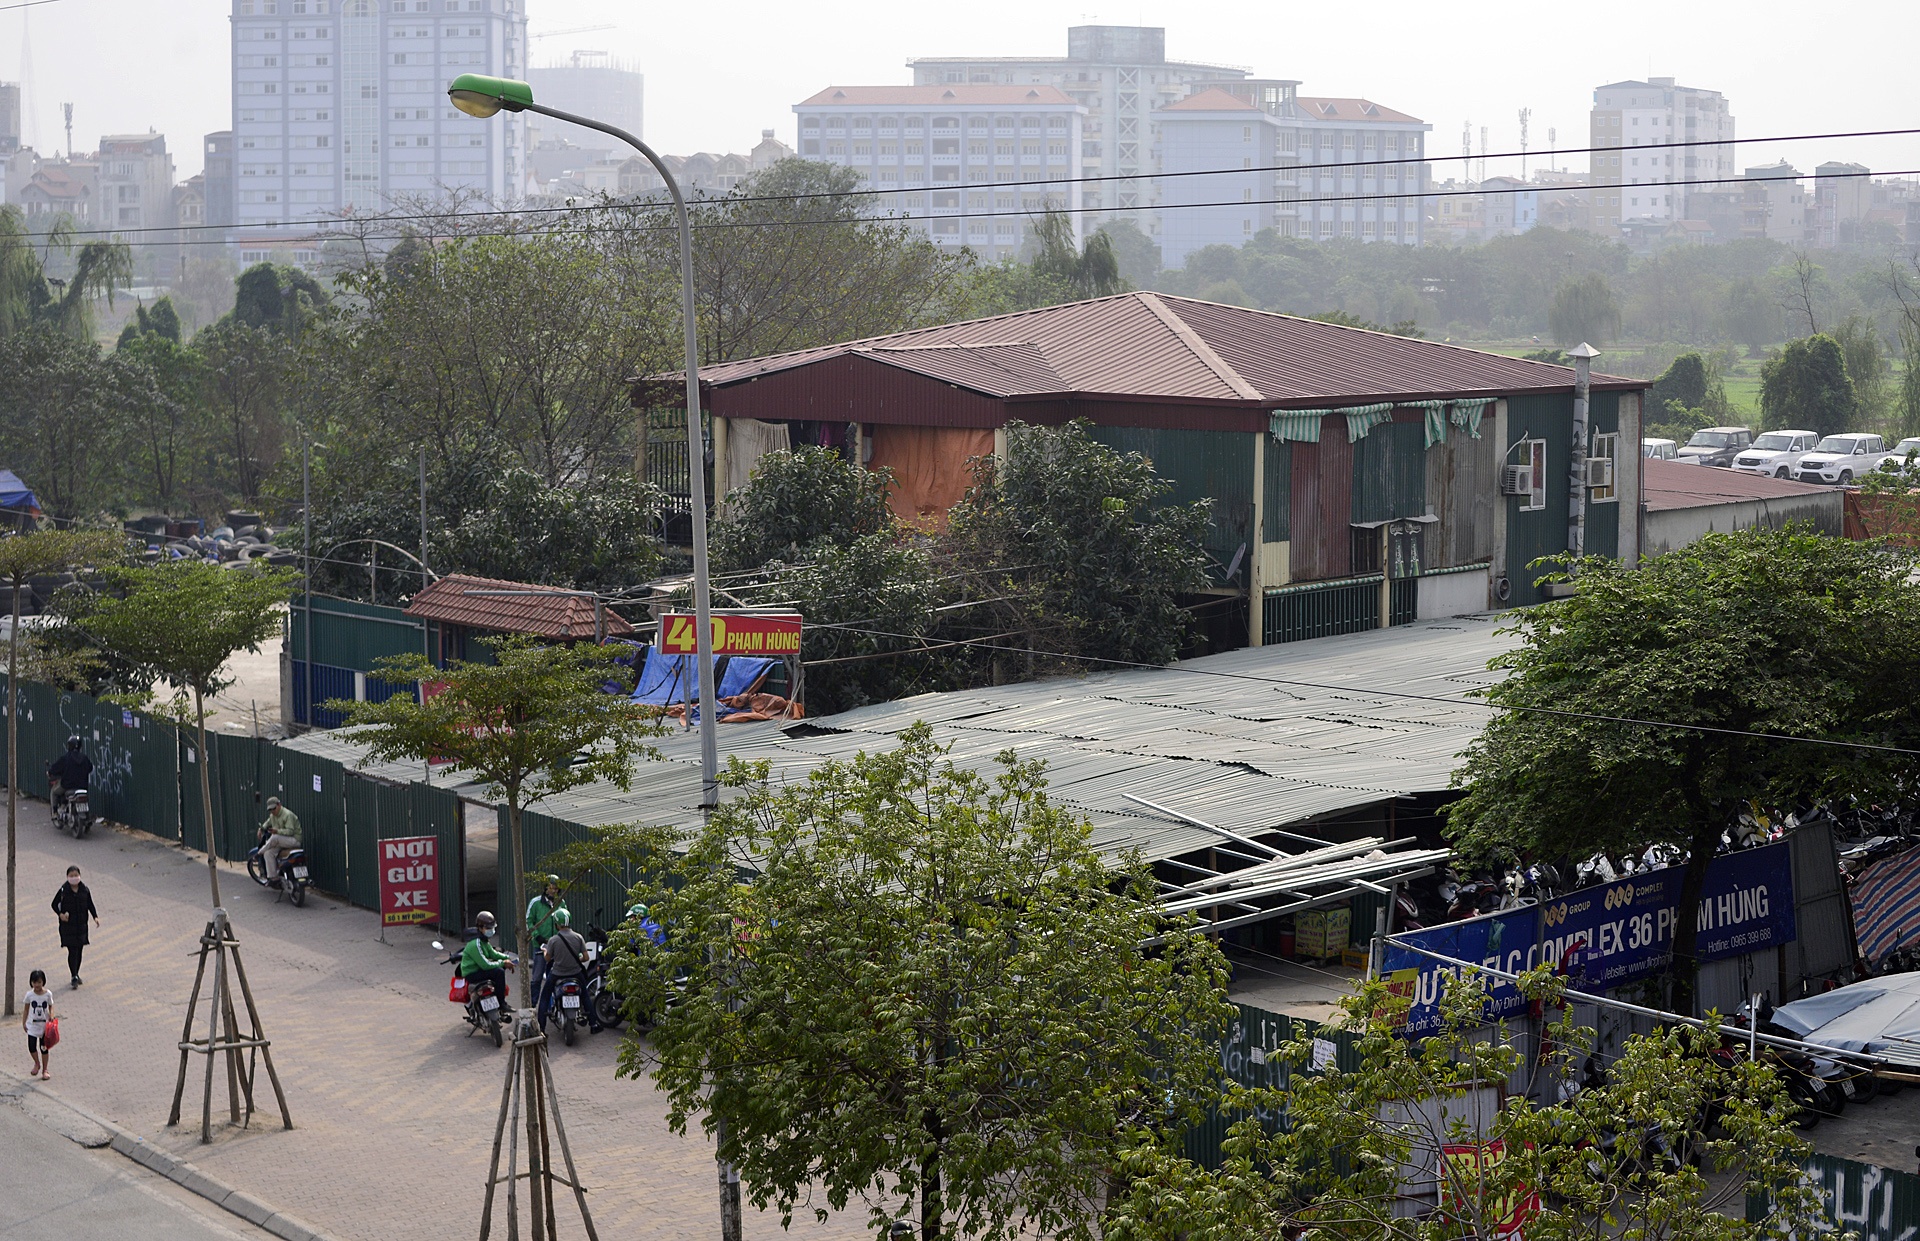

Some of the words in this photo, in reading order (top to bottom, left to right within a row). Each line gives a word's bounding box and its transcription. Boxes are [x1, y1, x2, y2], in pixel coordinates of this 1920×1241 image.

[727, 632, 763, 654] PHẠM
[766, 629, 800, 650] HÙNG
[385, 840, 433, 859] NƠI
[387, 860, 433, 883] GỬI
[393, 890, 428, 907] XE
[1606, 884, 1633, 907] FLC
[1635, 882, 1664, 897] COMPLEX
[1569, 900, 1591, 915] GROUP
[1482, 949, 1521, 991] FLC
[1629, 913, 1653, 949] 36
[1657, 898, 1713, 942] PHM
[1717, 884, 1769, 927] HÙNG
[1707, 939, 1730, 953] Hotline:
[1730, 933, 1747, 948] 0965
[1747, 930, 1759, 944] 399
[1760, 927, 1772, 941] 688
[1403, 979, 1414, 997] XE
